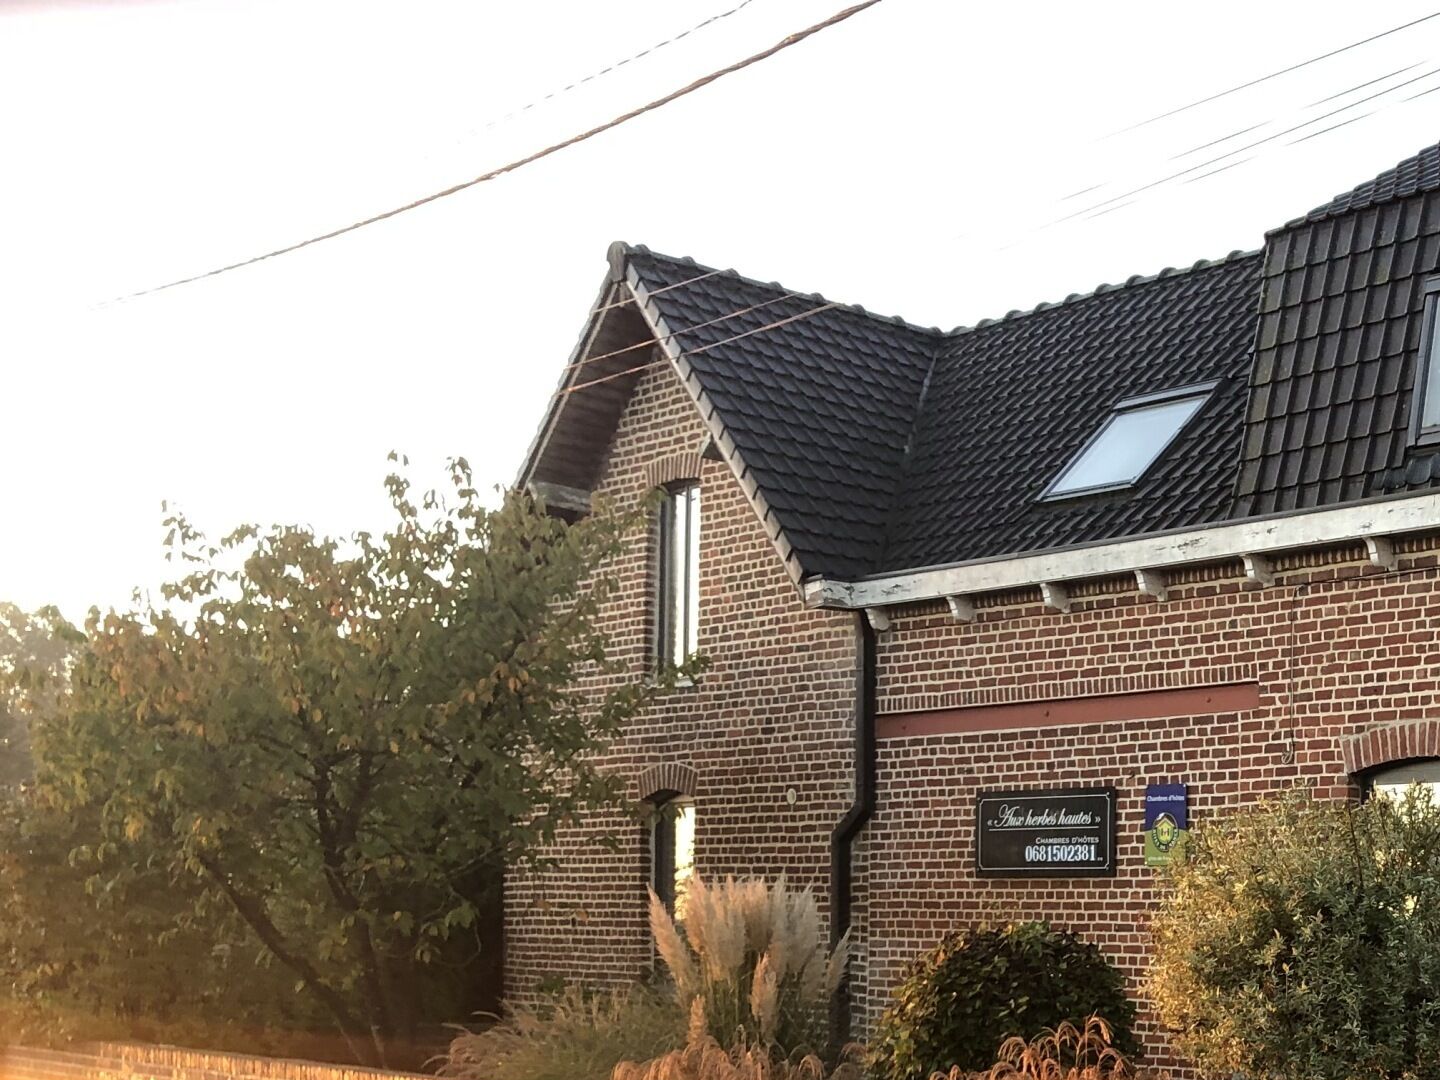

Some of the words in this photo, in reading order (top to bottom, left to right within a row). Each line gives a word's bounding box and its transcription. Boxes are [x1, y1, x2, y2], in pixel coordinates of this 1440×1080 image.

[994, 804, 1024, 827] Aux
[1025, 808, 1056, 826] herbes
[1058, 807, 1092, 825] hautes
[1025, 844, 1095, 862] 0681502381
